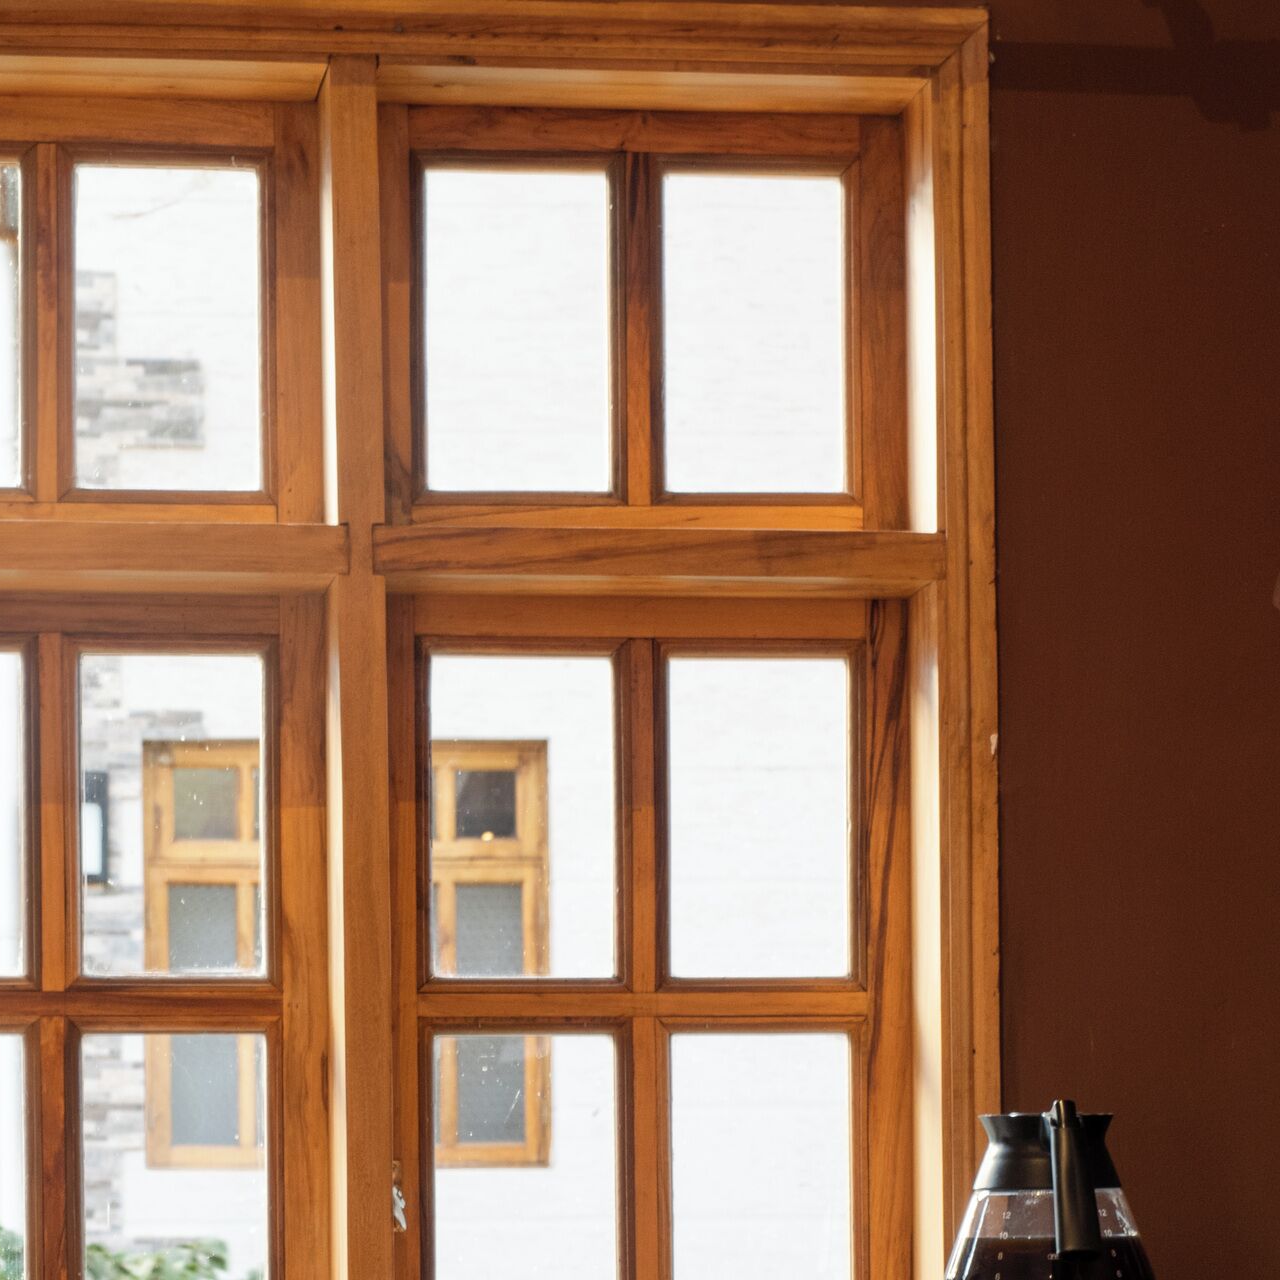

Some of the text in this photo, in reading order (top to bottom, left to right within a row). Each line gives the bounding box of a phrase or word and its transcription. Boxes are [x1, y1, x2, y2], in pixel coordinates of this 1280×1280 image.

[1000, 1232, 1009, 1240] 10
[1104, 1229, 1112, 1237] 10
[995, 1272, 1000, 1280] 6
